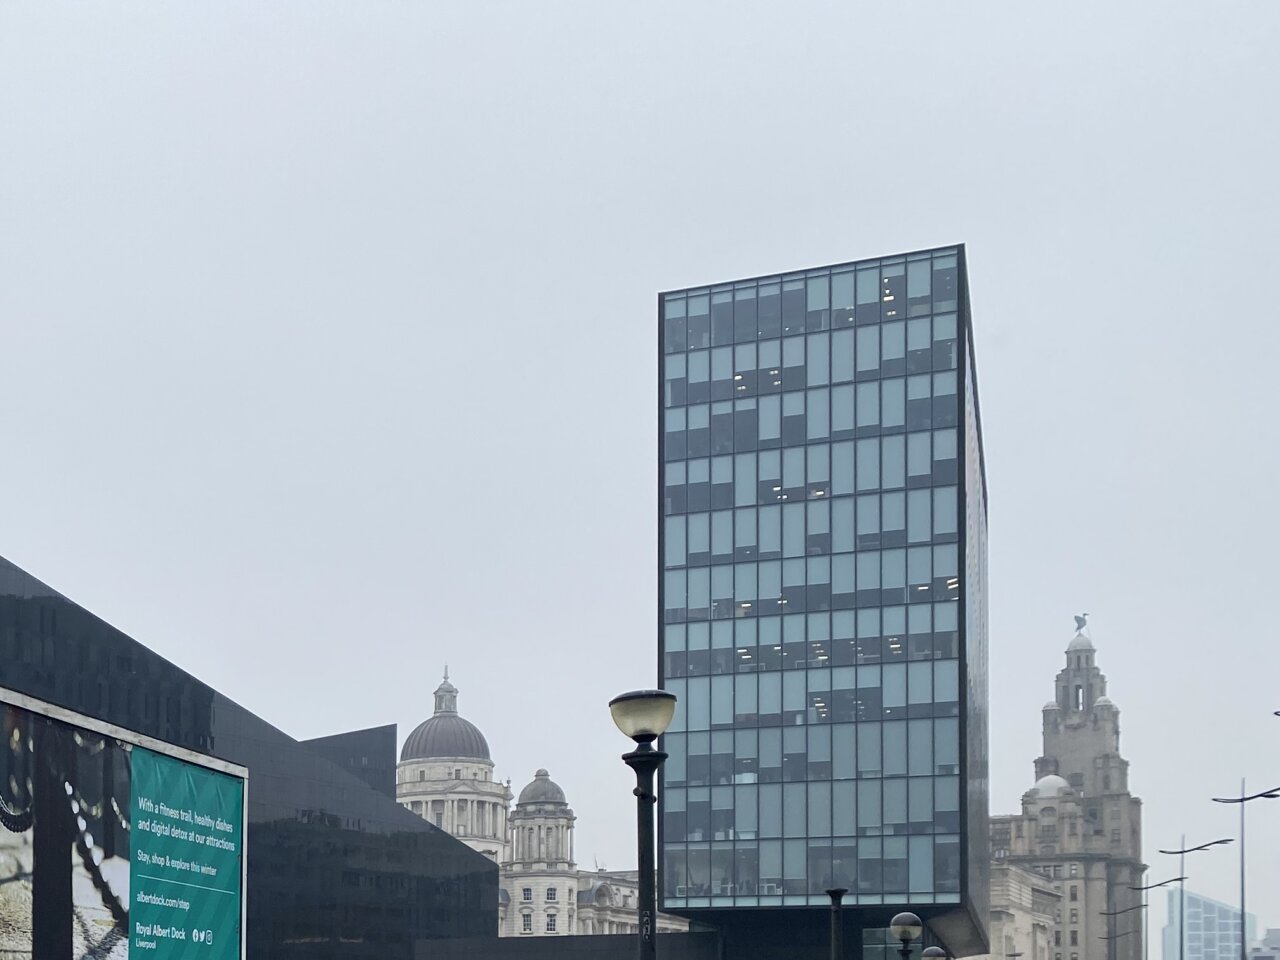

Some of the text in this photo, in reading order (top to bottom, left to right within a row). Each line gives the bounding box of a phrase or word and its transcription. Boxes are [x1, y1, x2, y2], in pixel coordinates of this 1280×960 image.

[138, 796, 154, 812] With
[159, 802, 180, 819] fitness
[180, 809, 194, 825] trail,
[194, 811, 215, 831] healthy
[215, 818, 233, 833] dishes
[138, 818, 235, 851] and digital detox at our attractions
[137, 849, 151, 864] Stay,
[151, 852, 165, 867] shop
[170, 858, 190, 871] explore
[190, 861, 200, 873] this
[200, 863, 217, 876] winter
[137, 891, 190, 912] albertdock.com/step
[136, 922, 186, 940] Royal Albert Dock
[135, 938, 157, 949] Liverpool
